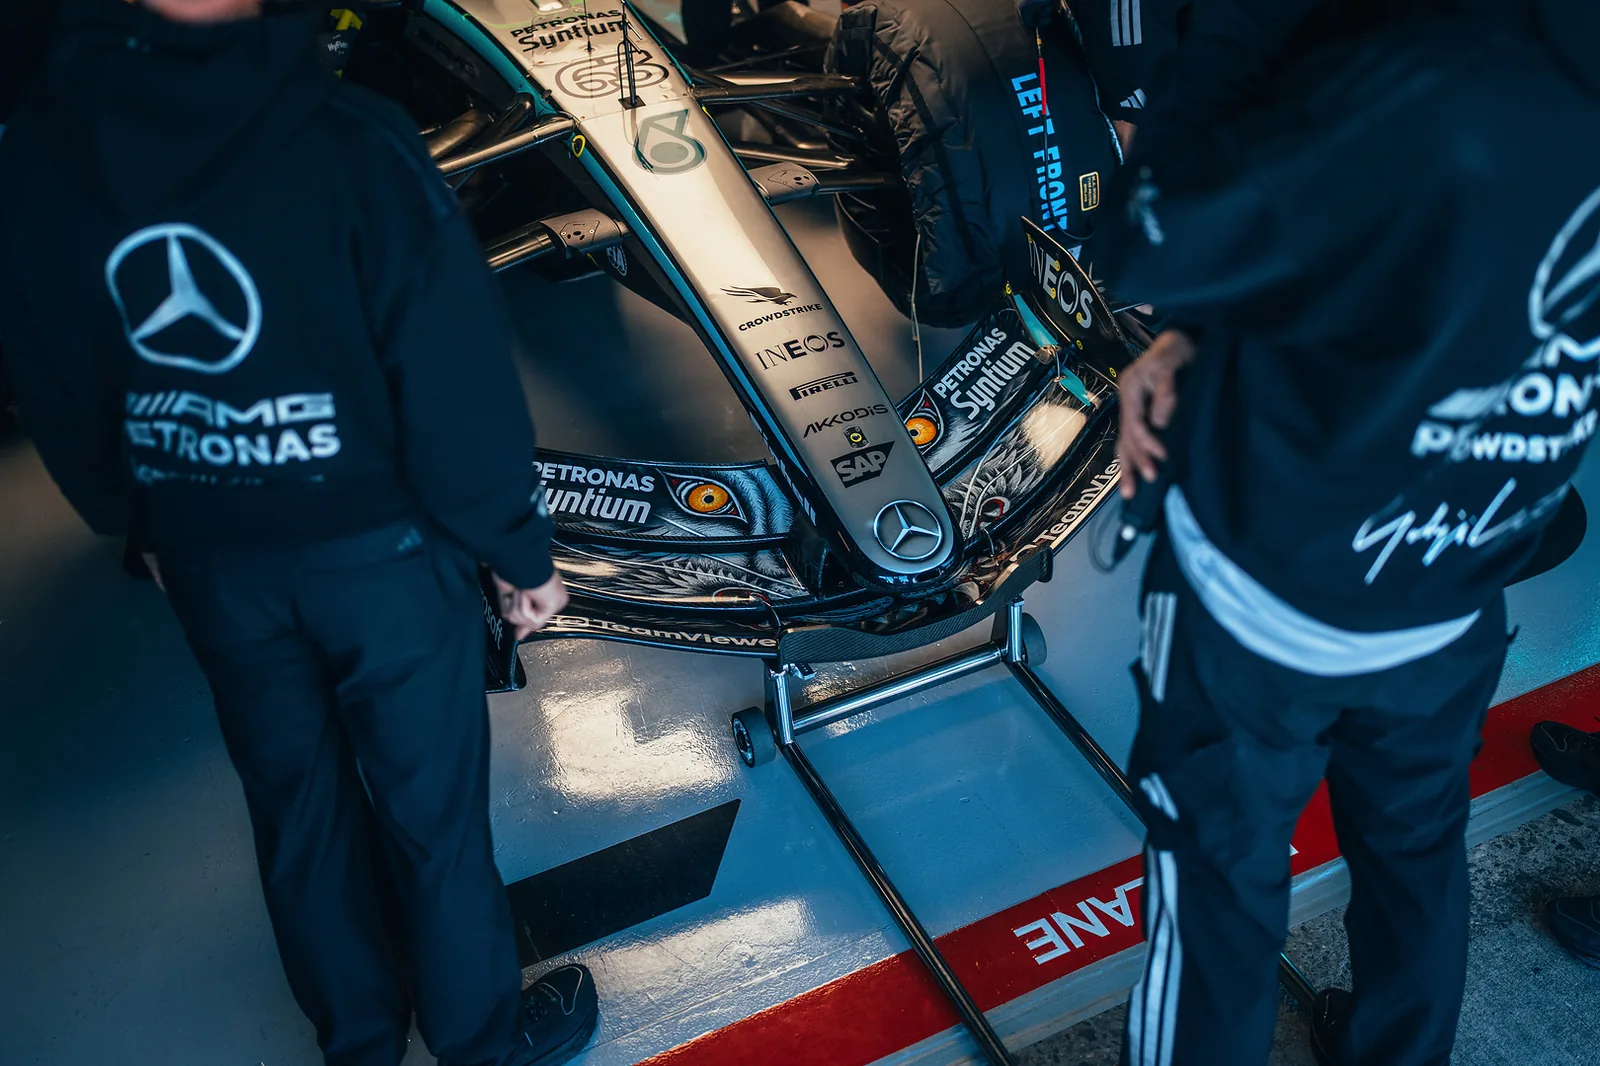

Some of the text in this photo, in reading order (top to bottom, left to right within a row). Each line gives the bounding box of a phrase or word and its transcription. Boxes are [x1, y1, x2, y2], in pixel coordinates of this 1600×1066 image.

[511, 10, 622, 37] PETRONAS
[518, 20, 625, 52] Syntium
[555, 50, 669, 99] 63
[1011, 72, 1067, 232] LEFT FRONT
[1028, 239, 1093, 329] INEOS
[738, 303, 823, 332] CROWDSTRIKE
[754, 331, 845, 370] INEOS
[933, 327, 1007, 399] PETRONAS
[789, 371, 858, 401] PIRELLI
[950, 341, 1035, 420] Syntium
[126, 422, 341, 466] ETRONAS
[836, 450, 887, 482] SAP
[540, 480, 651, 524] yntium
[1033, 454, 1121, 543] TeamVie
[592, 619, 779, 647] TeamViewe
